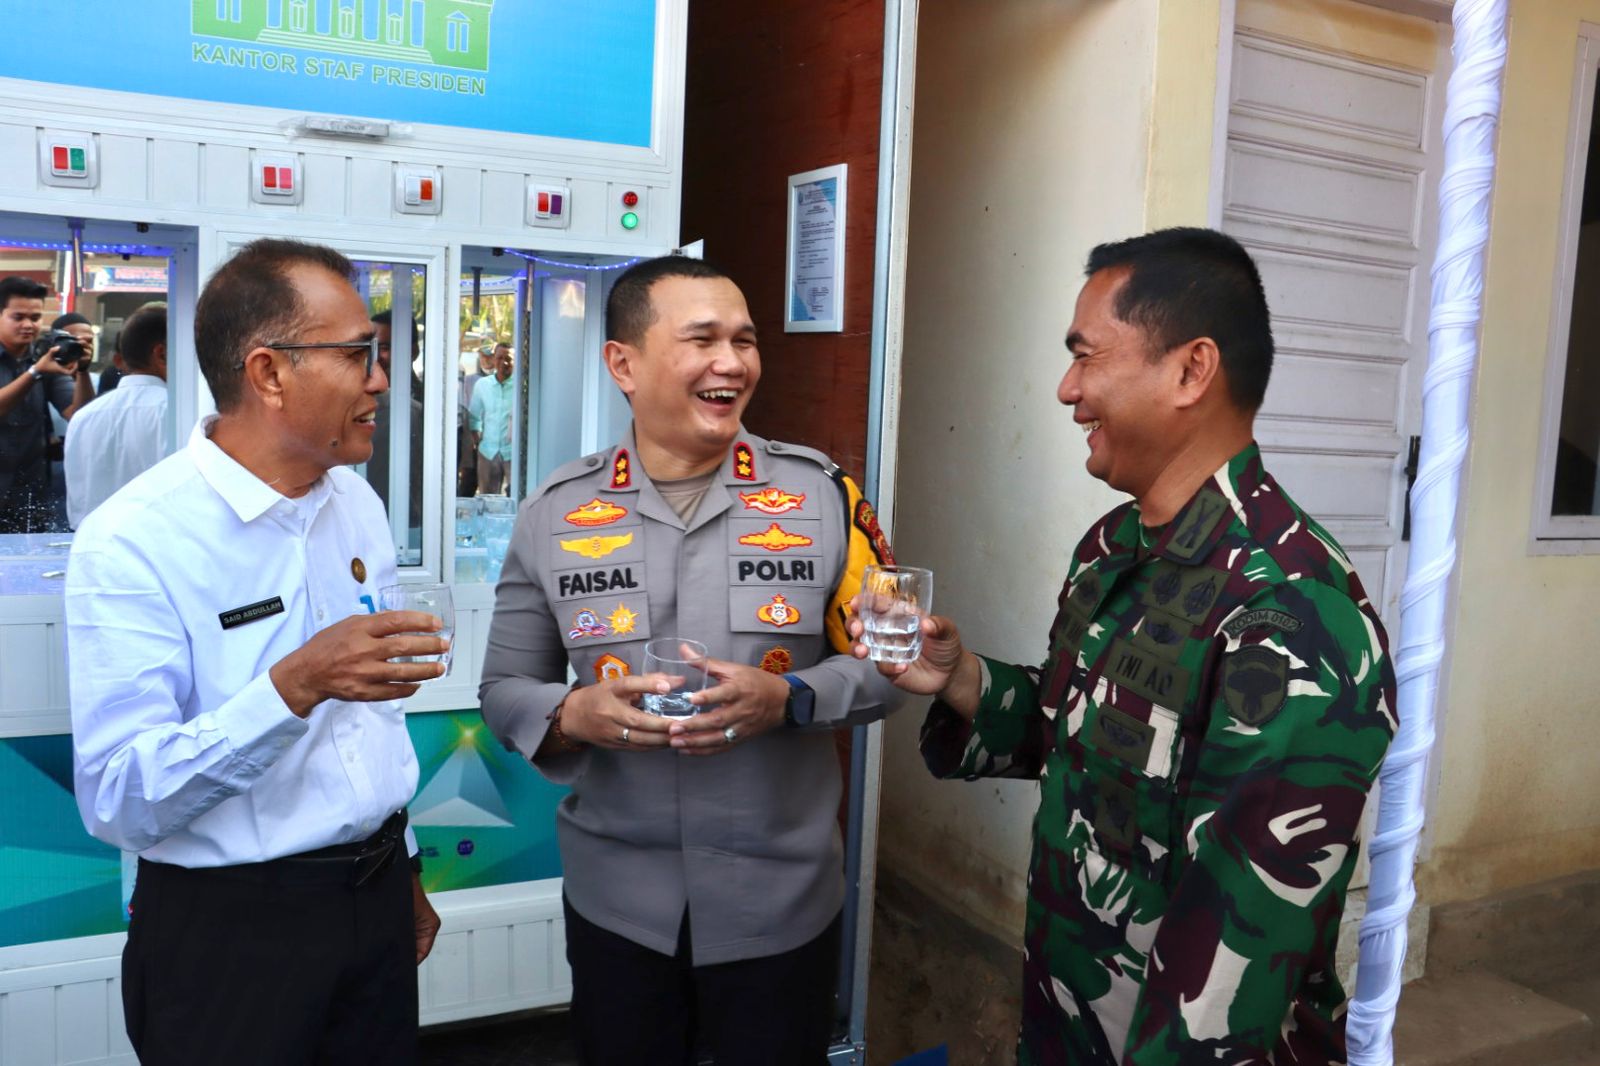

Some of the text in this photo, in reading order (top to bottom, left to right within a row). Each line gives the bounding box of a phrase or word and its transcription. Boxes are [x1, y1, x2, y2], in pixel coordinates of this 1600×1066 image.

[192, 42, 486, 96] KANTOR STAF PRESIDEN
[559, 567, 638, 597] FAISAL
[738, 560, 815, 582] POLRI
[223, 601, 281, 624] SAID ABDULLAH
[1230, 611, 1299, 633] KODIM 0102
[1115, 652, 1143, 681] TNI
